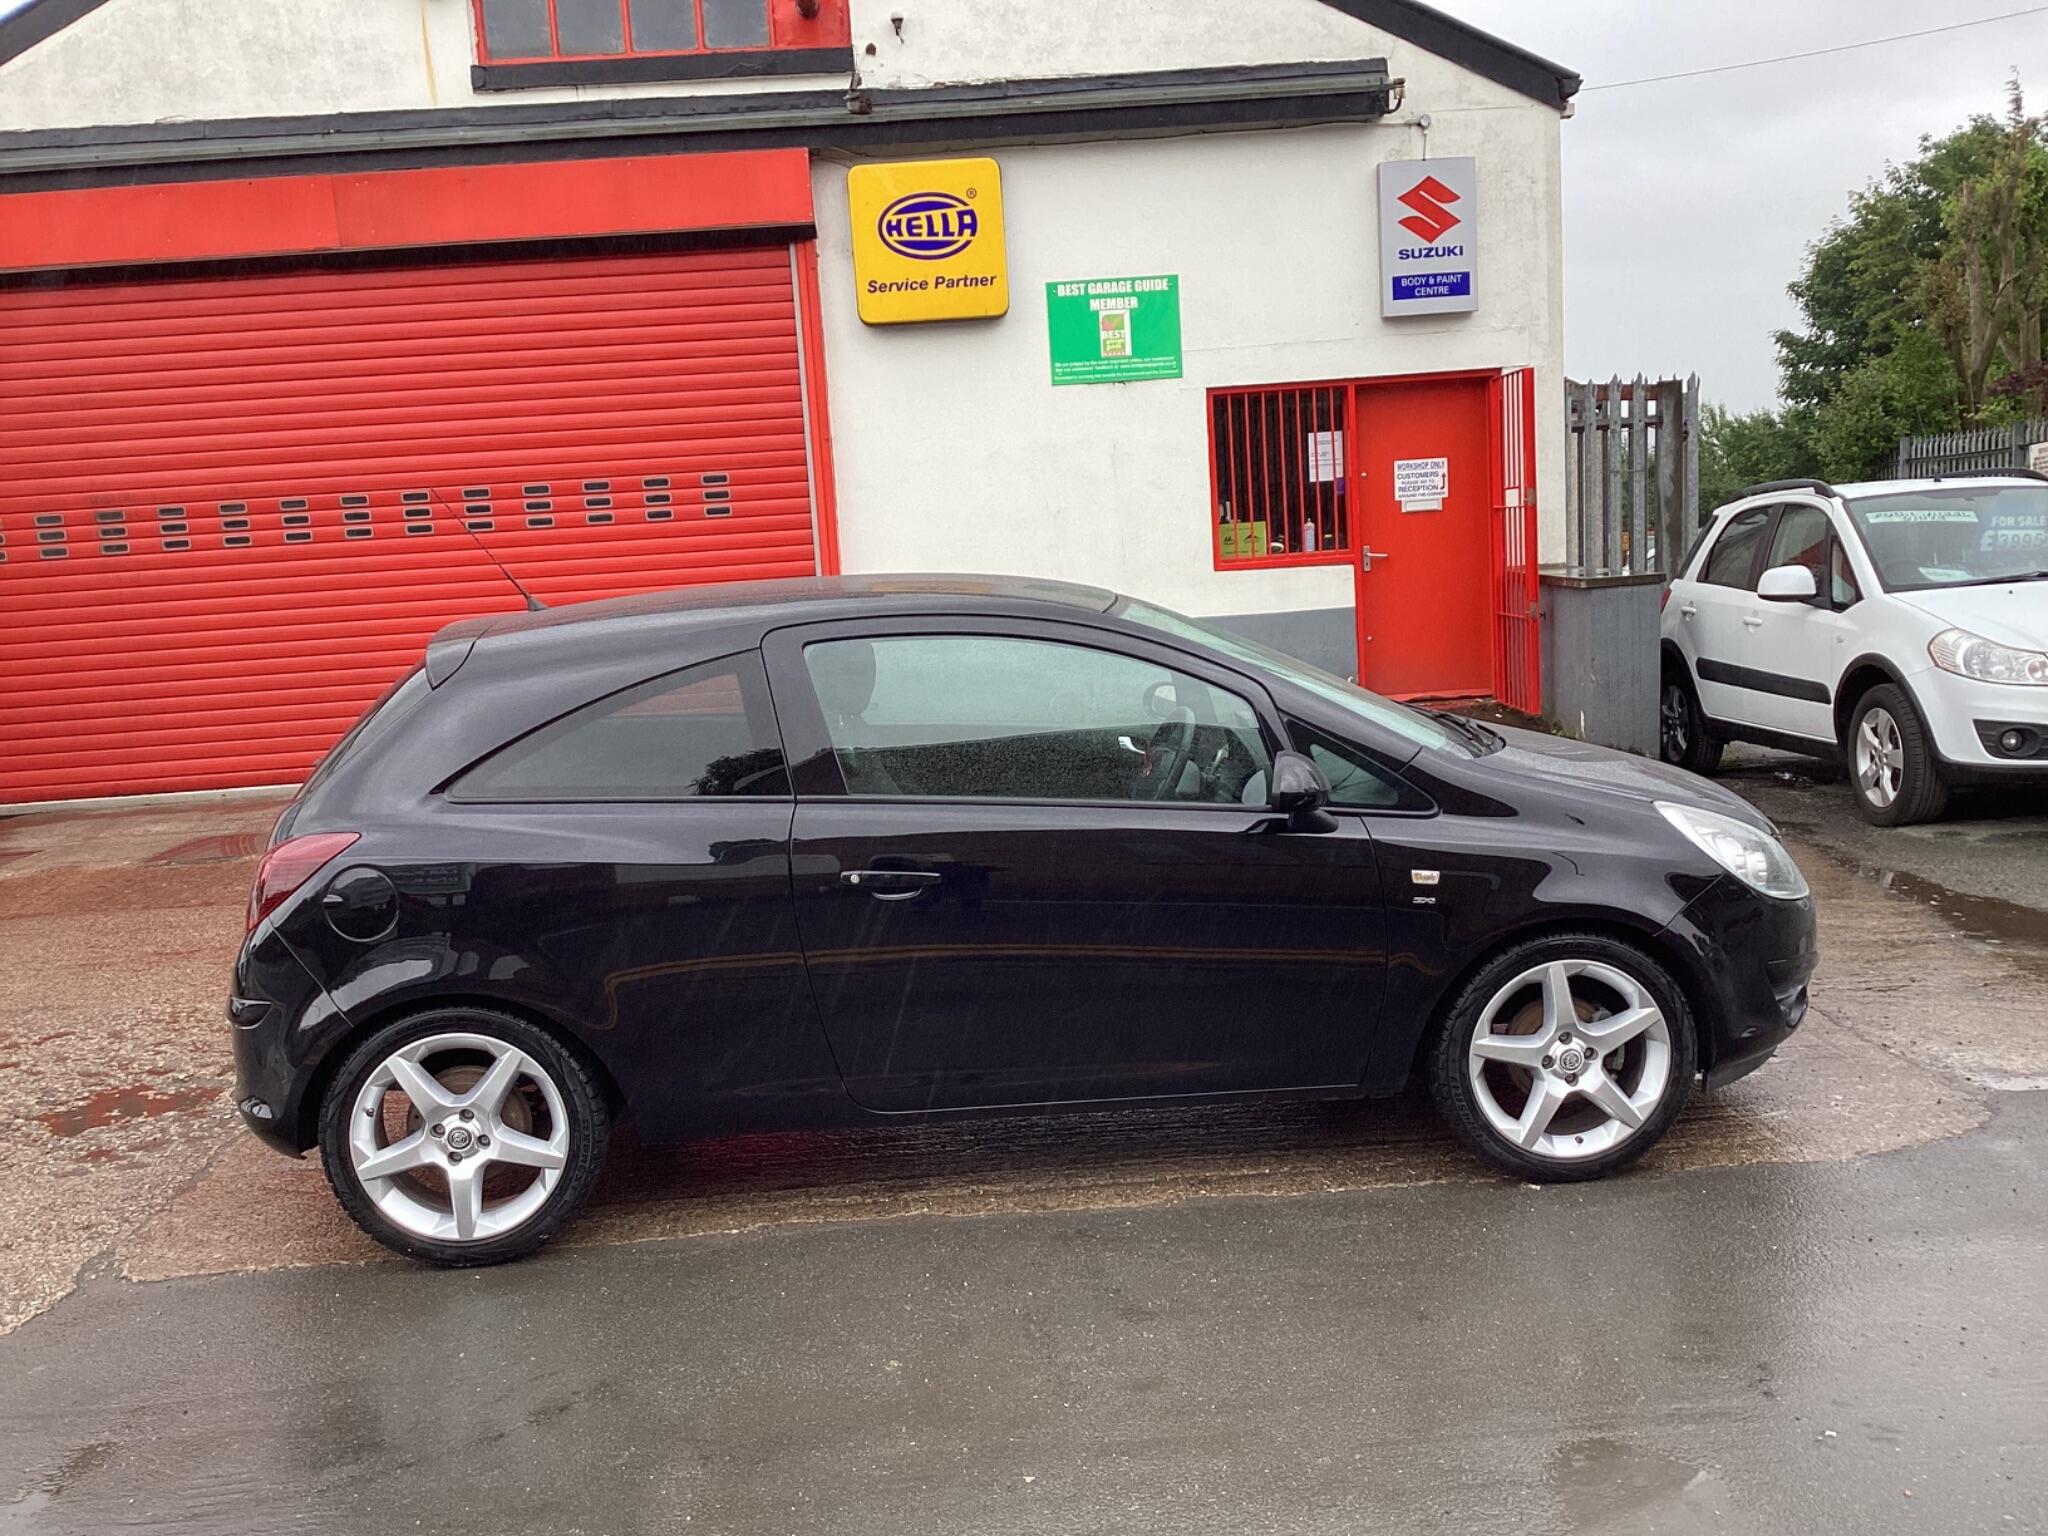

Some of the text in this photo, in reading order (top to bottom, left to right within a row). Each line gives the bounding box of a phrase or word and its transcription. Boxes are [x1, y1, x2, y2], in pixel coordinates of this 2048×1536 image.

[885, 208, 978, 237] HELLA
[1398, 245, 1464, 260] SUZUKI
[867, 274, 997, 293] Service Partner
[1056, 278, 1169, 297] BEST GARAGE GUIDE
[1401, 275, 1462, 287] BODY & PAINT
[1415, 286, 1450, 296] CENTRE
[1089, 296, 1138, 311] MEMBER
[1397, 461, 1445, 470] WORKSHOP ONLY
[1397, 471, 1439, 480] CUSTOMERS
[1991, 515, 2047, 527] FOR SALE
